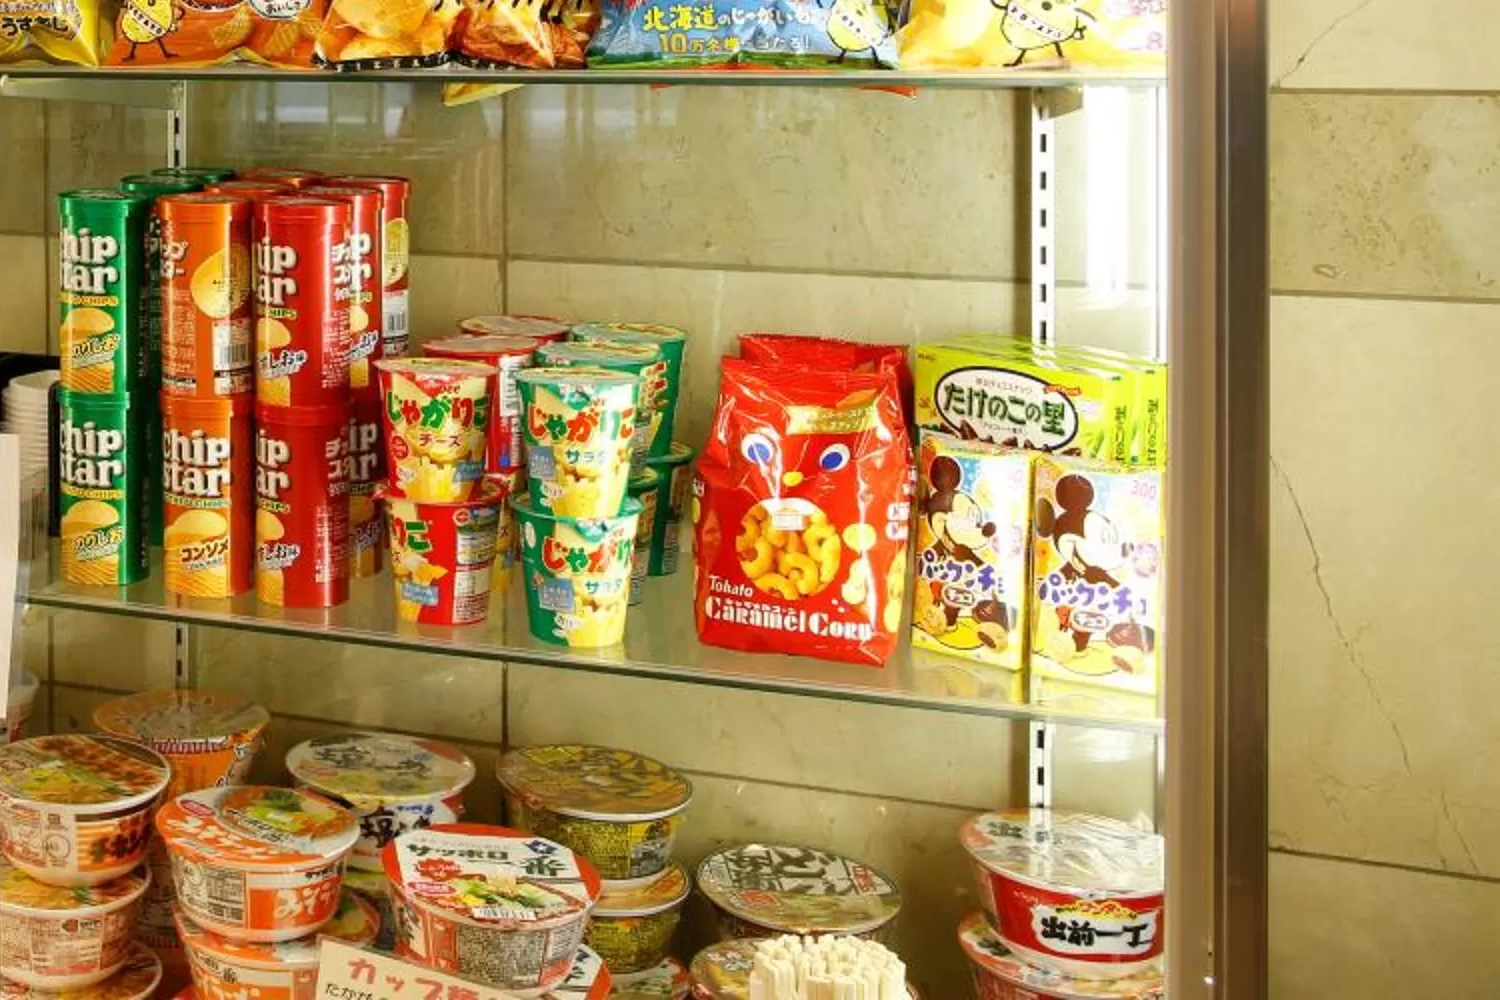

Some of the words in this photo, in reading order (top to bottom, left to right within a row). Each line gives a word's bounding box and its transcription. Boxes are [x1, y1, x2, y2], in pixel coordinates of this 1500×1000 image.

[61, 262, 118, 297] tar
[942, 381, 1067, 437] たけのこの里
[162, 429, 231, 467] chip
[418, 431, 462, 449] チーズ
[162, 462, 231, 499] star
[707, 574, 754, 597] Tohato
[1040, 914, 1150, 949] 出前一丁
